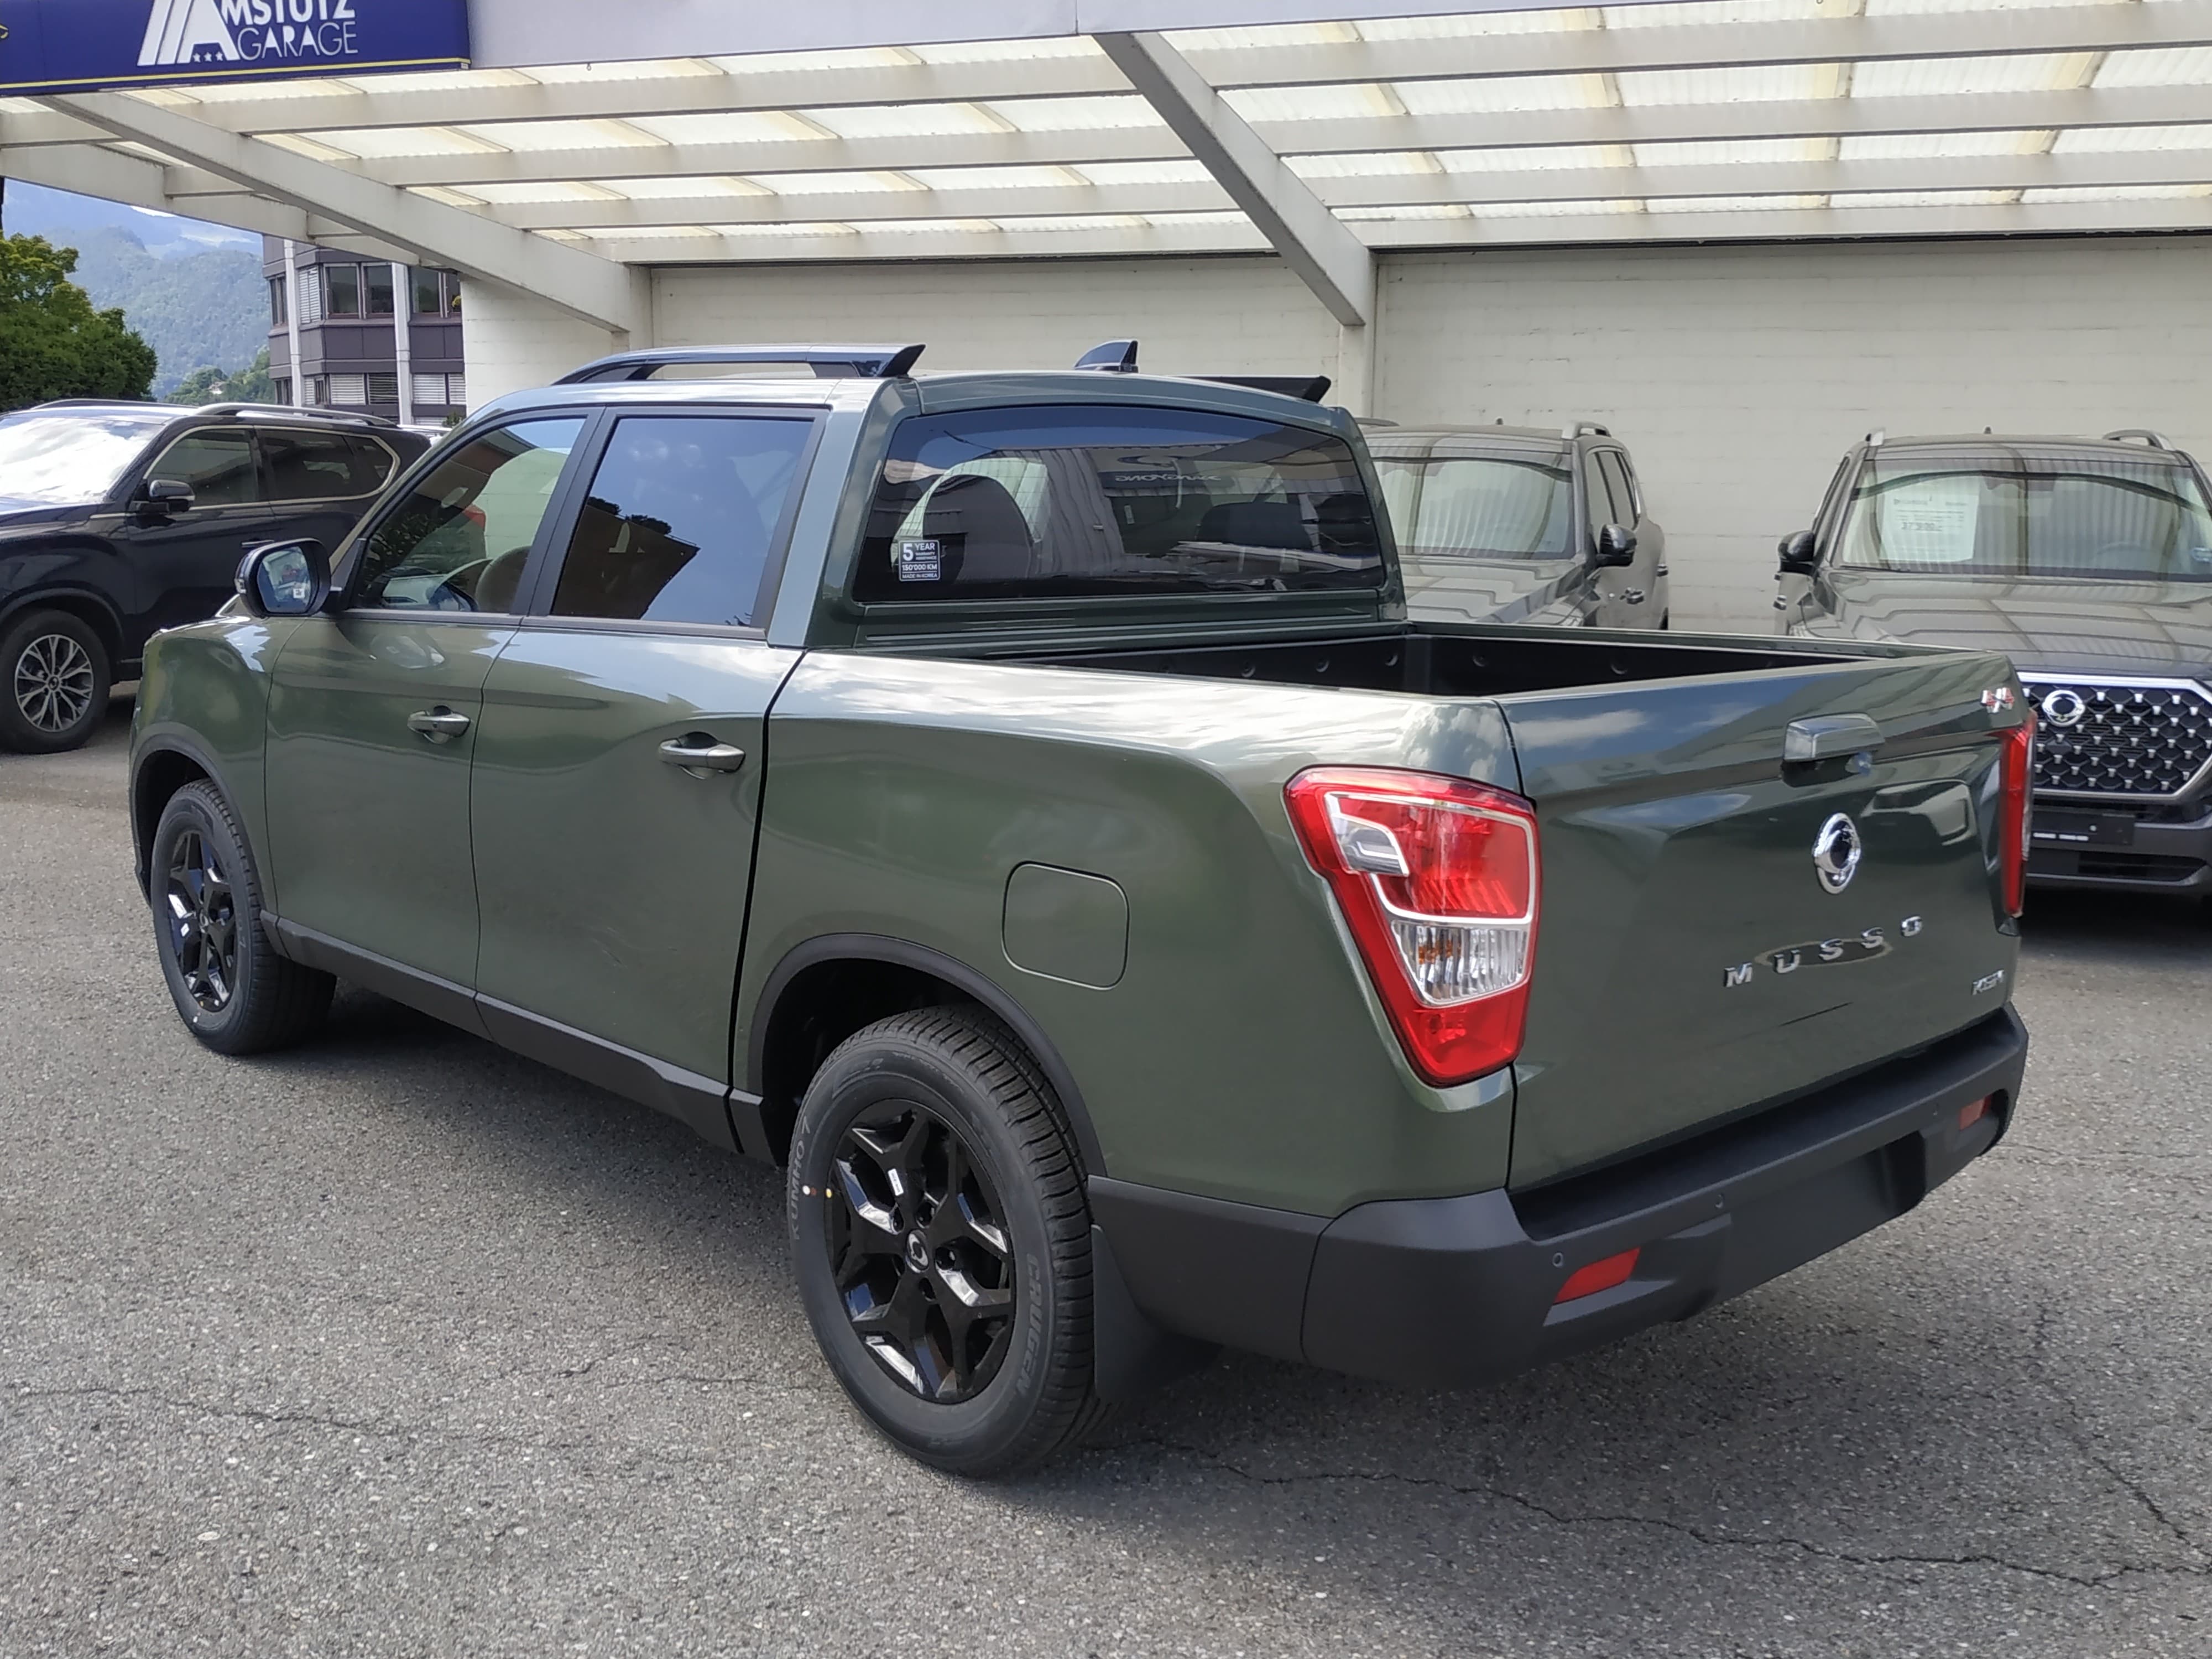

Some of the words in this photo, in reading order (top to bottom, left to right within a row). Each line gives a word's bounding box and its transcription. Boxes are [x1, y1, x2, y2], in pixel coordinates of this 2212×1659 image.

[237, 21, 358, 60] GARAGE
[902, 543, 914, 561] 5
[915, 542, 935, 551] YEAR
[1723, 914, 1923, 987] MUSSO
[791, 1140, 805, 1240] KUMHO
